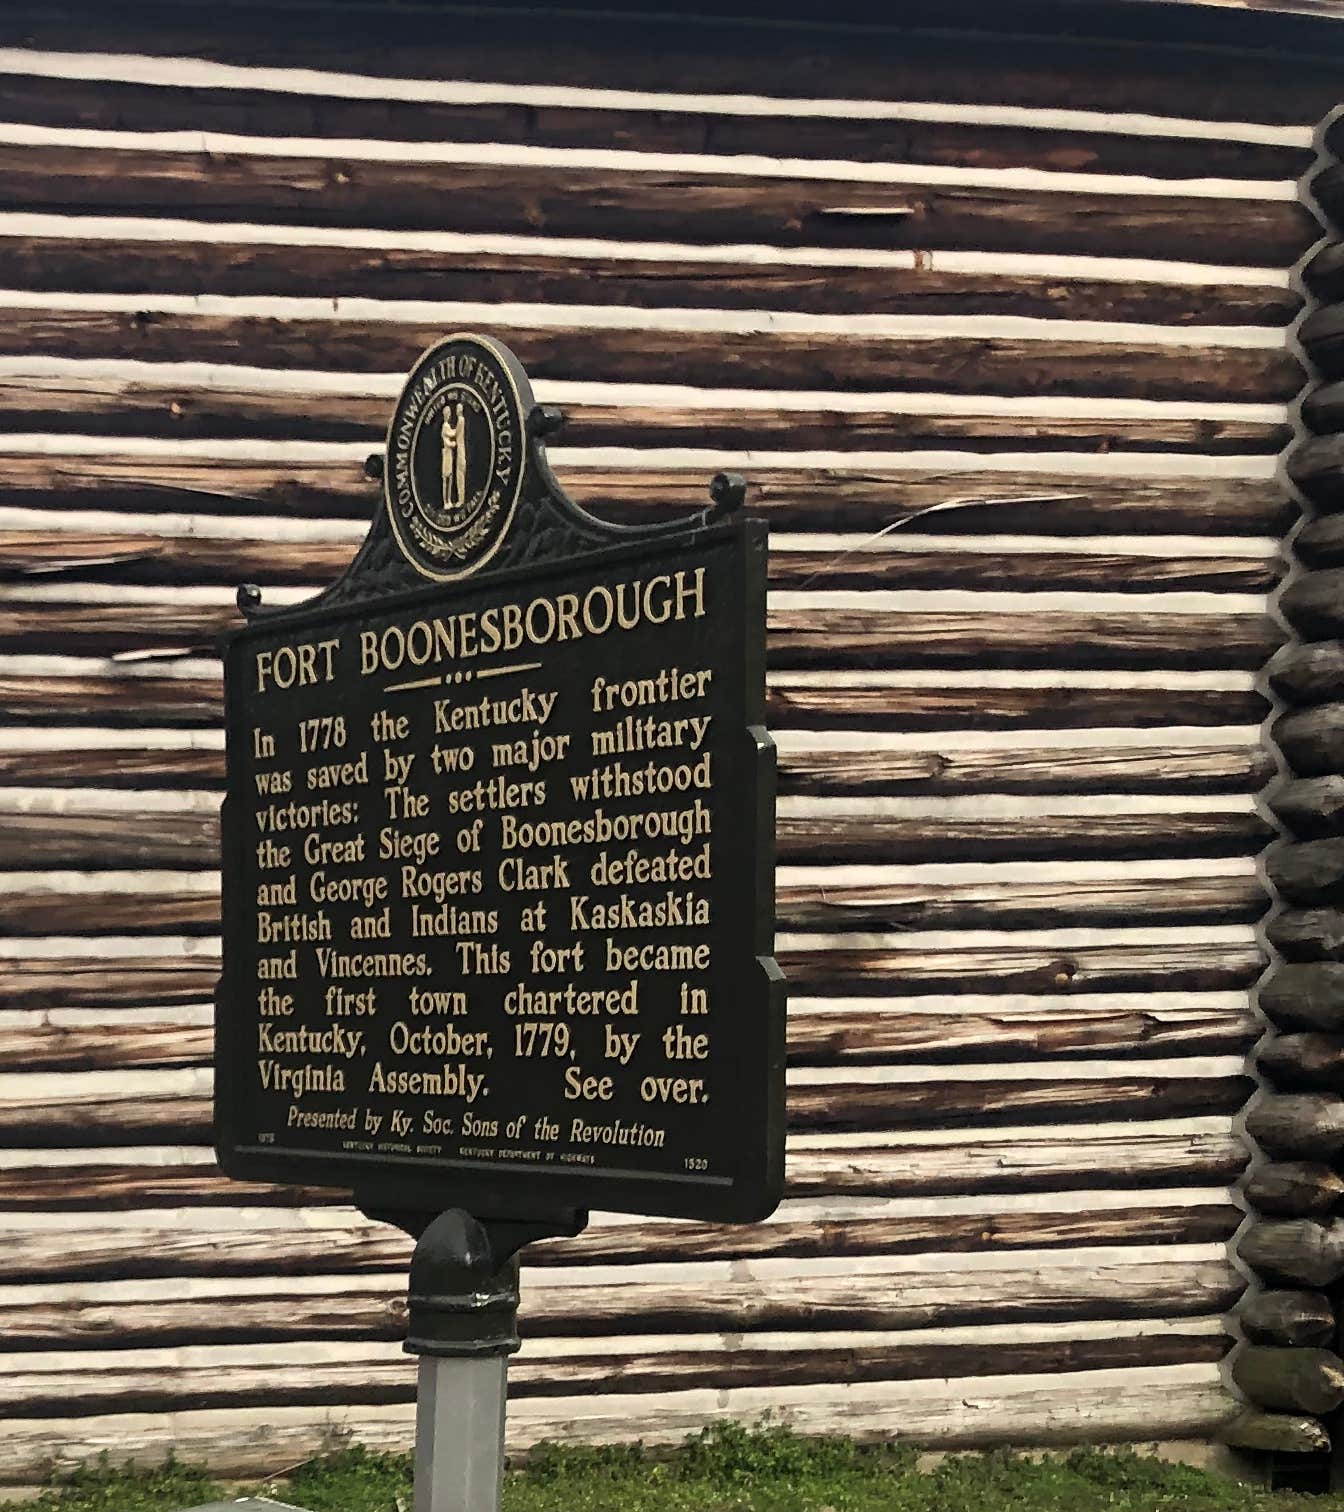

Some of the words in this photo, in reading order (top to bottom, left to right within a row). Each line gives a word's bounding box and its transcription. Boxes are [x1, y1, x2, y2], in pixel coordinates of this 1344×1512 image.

[396, 355, 456, 518] COMMONWEALTH
[458, 355, 477, 377] OF
[474, 362, 512, 486] KENTUCKY
[256, 639, 339, 692] FORT
[360, 567, 706, 674] BOONESBOROUGH
[254, 728, 275, 759] In
[300, 716, 346, 753] 1778
[371, 710, 409, 742] the
[434, 688, 558, 734] Kentucky
[591, 668, 712, 712] frontier
[255, 771, 293, 796] was
[308, 751, 368, 790] saved
[384, 749, 415, 785] by
[431, 745, 474, 775] two
[492, 729, 570, 771] major
[591, 715, 711, 755] military
[256, 800, 359, 832] victories:
[384, 786, 430, 819] The
[449, 775, 546, 813] settlers
[571, 752, 711, 801] withstood
[257, 839, 291, 869] the
[304, 833, 365, 865] Great
[379, 828, 440, 864] Siege
[457, 819, 483, 852] of
[501, 799, 711, 850] Boonesborough
[257, 875, 296, 906] and
[310, 871, 388, 907] George
[401, 866, 482, 903] Rogers
[498, 855, 570, 892] Clark
[590, 843, 711, 886] defeated
[257, 910, 332, 943] British
[350, 907, 391, 939] and
[412, 904, 498, 936] Indians
[520, 901, 546, 932] at
[571, 891, 710, 930] Kaskaskia
[258, 950, 297, 979] and
[315, 948, 432, 978] Vincennes.
[456, 941, 510, 975] This
[530, 941, 584, 973] fort
[606, 938, 710, 971] became
[258, 987, 294, 1016] the
[325, 986, 376, 1016] first
[409, 986, 468, 1015] town
[504, 980, 638, 1015] chartered
[680, 982, 708, 1015] in
[258, 1023, 366, 1058] Kentucky,
[390, 1021, 493, 1059] October,
[515, 1023, 576, 1061] 1779,
[605, 1024, 641, 1064] by
[662, 1024, 709, 1059] the
[258, 1059, 345, 1098] Virginia
[369, 1061, 488, 1103] Assembly.
[565, 1066, 613, 1100] See
[640, 1076, 708, 1104] over.
[287, 1105, 358, 1130] Presented
[364, 1108, 383, 1135] by
[390, 1110, 413, 1137] Ky.
[423, 1109, 454, 1135] Soc.
[462, 1112, 498, 1137] Sons
[506, 1115, 527, 1139] of
[534, 1116, 559, 1141] the
[569, 1118, 665, 1148] Revolution
